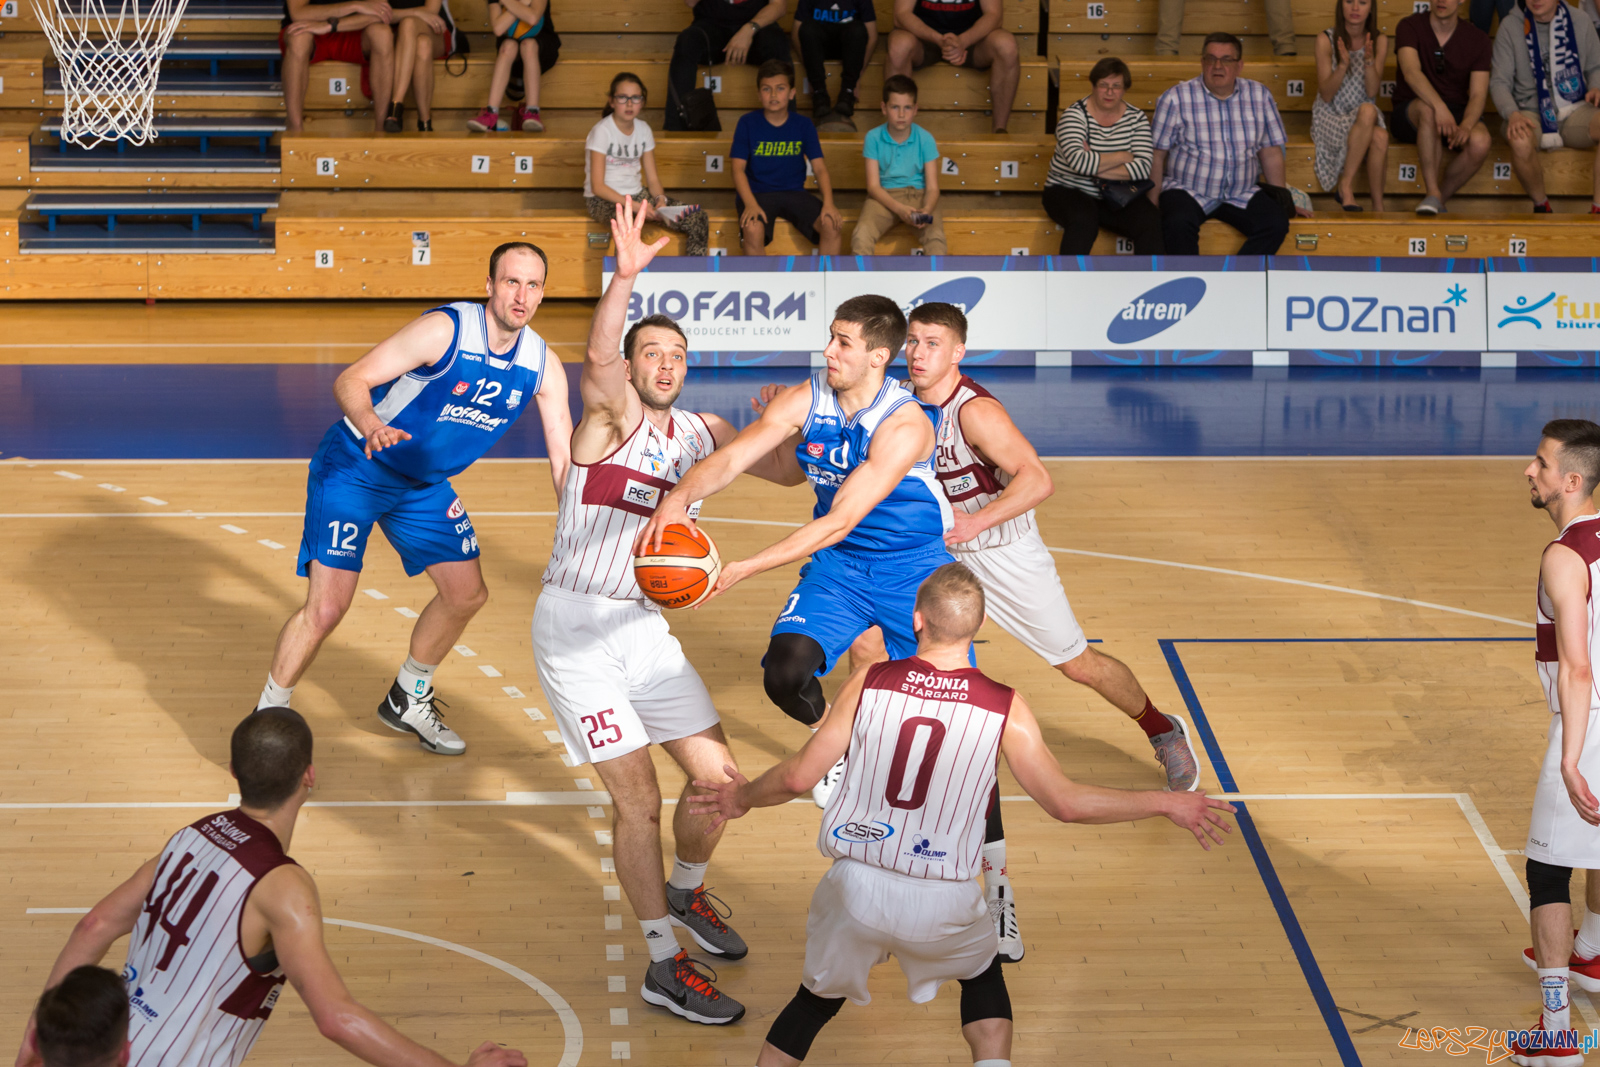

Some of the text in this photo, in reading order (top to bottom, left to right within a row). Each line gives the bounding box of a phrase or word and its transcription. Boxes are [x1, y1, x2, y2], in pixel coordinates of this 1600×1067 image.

[5, 3, 13, 14] 9
[1089, 5, 1103, 16] 16
[335, 81, 342, 93] 8
[1289, 82, 1303, 94] 14
[754, 141, 802, 156] ADIDAS
[323, 161, 330, 172] 8
[477, 158, 485, 170] 7
[521, 159, 528, 170] 6
[710, 158, 719, 170] 4
[946, 160, 956, 172] 2
[1007, 163, 1013, 175] 1
[1402, 167, 1416, 179] 13
[1495, 166, 1510, 177] 12
[1118, 240, 1132, 252] 16
[1411, 241, 1426, 253] 13
[1512, 242, 1526, 253] 12
[322, 253, 329, 265] 8
[418, 250, 426, 262] 7
[1122, 299, 1188, 320] atrem
[753, 327, 791, 336] LEKÓW
[470, 378, 502, 407] 12
[937, 445, 958, 465] 24
[628, 487, 651, 501] PEC
[329, 520, 358, 550] 12
[906, 671, 969, 691] SPÓJNIA
[901, 683, 968, 700] STARGARD
[580, 708, 622, 749] 25
[885, 716, 946, 810] 0
[201, 823, 237, 850] STARGARD
[921, 849, 947, 858] OLIMP
